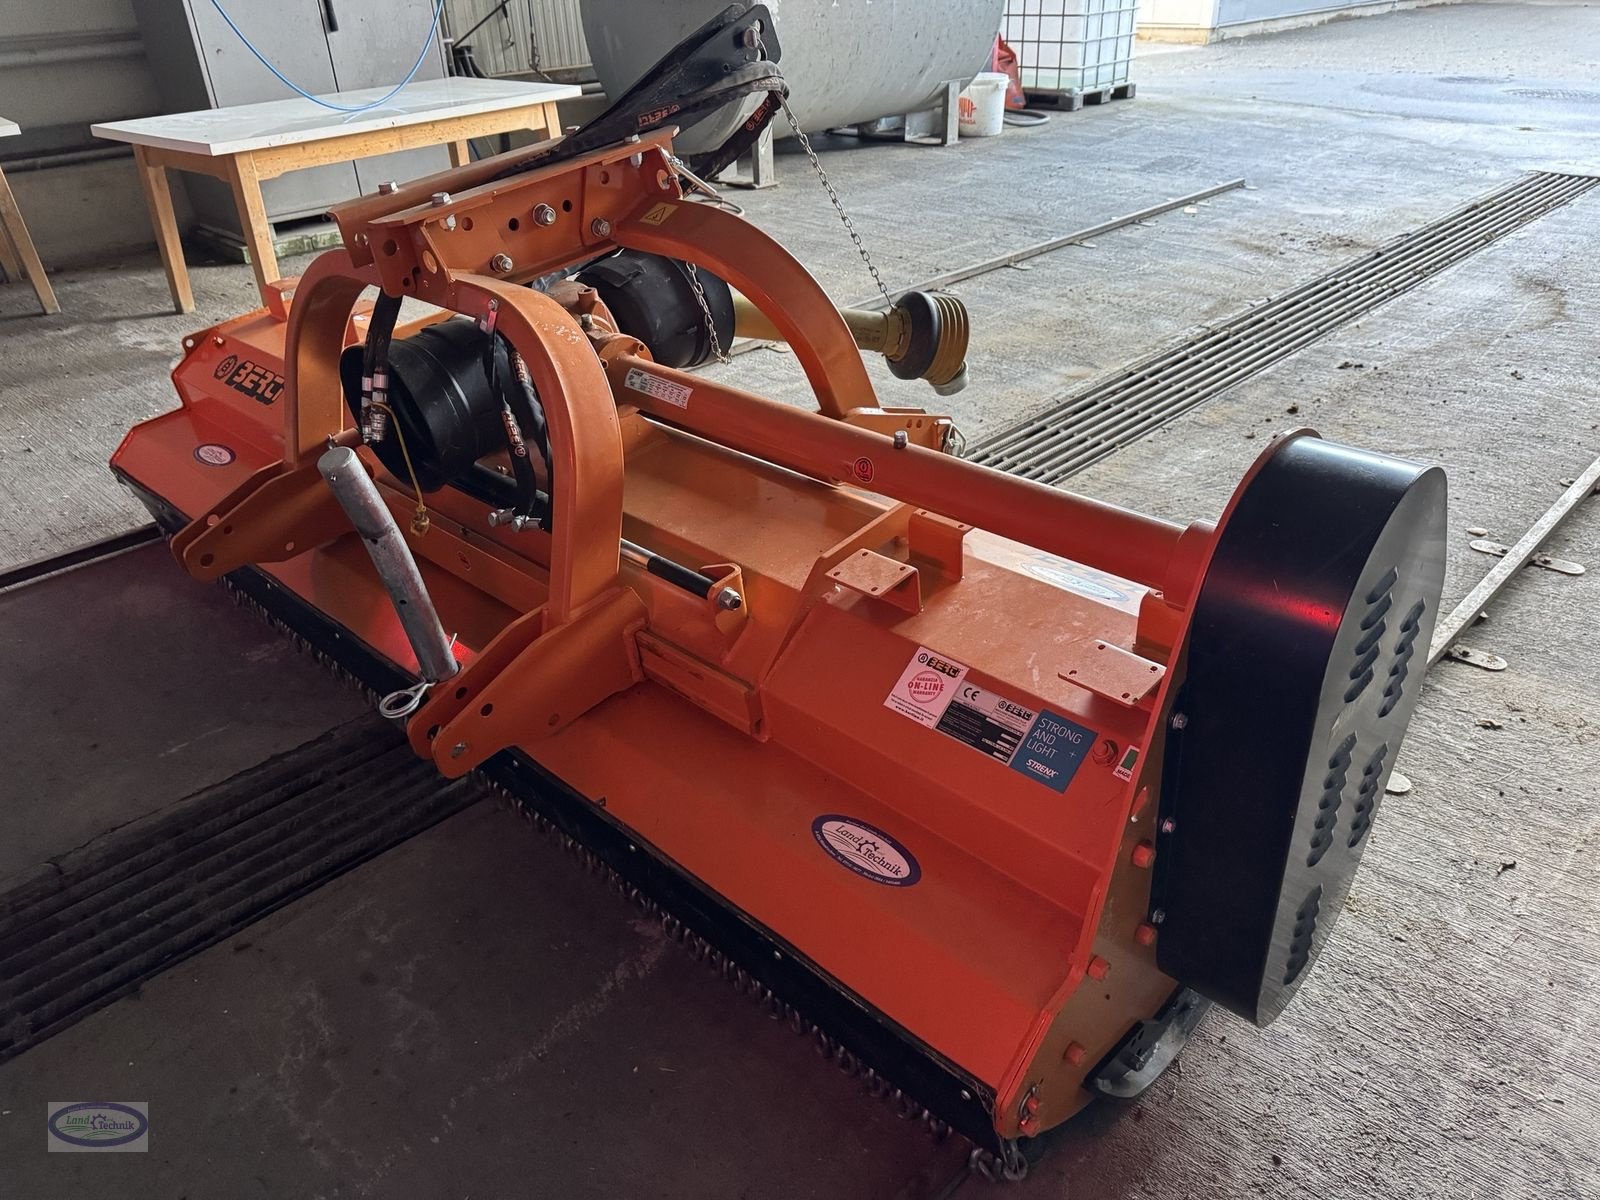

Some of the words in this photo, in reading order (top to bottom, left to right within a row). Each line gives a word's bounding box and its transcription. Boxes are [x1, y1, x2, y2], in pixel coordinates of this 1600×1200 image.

[907, 681, 945, 692] ON-LINE
[963, 687, 980, 701] CE
[1032, 729, 1057, 746] AND
[1038, 718, 1083, 744] STRONG
[1026, 738, 1058, 759] LIGHT
[835, 824, 864, 844] Land
[863, 846, 902, 876] Technik
